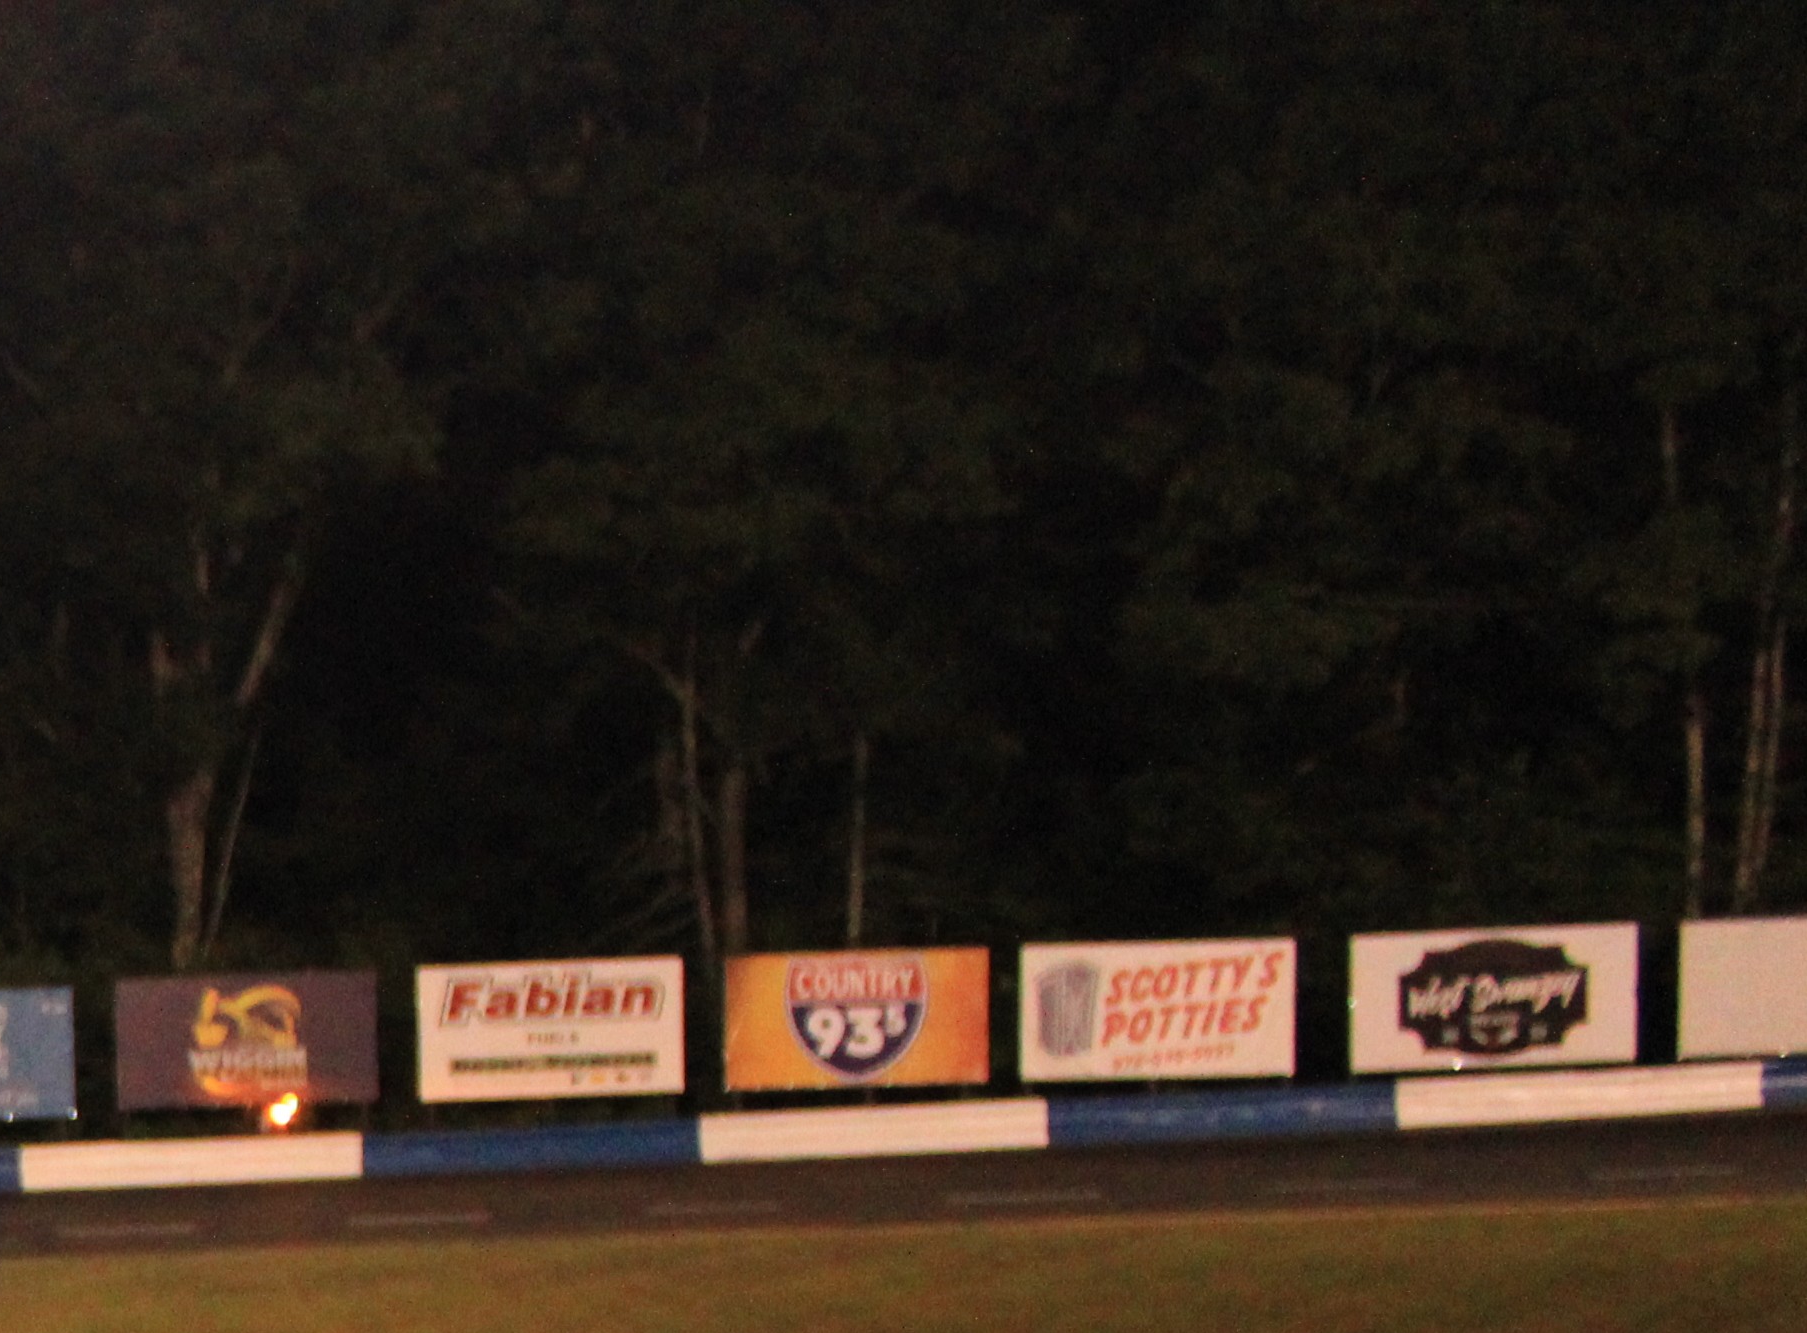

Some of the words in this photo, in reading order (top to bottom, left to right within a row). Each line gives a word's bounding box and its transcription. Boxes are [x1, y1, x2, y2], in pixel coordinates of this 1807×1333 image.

[441, 974, 662, 1024] Fabian
[795, 964, 915, 1000] COUNTRY
[1100, 995, 1268, 1047] POTTIES
